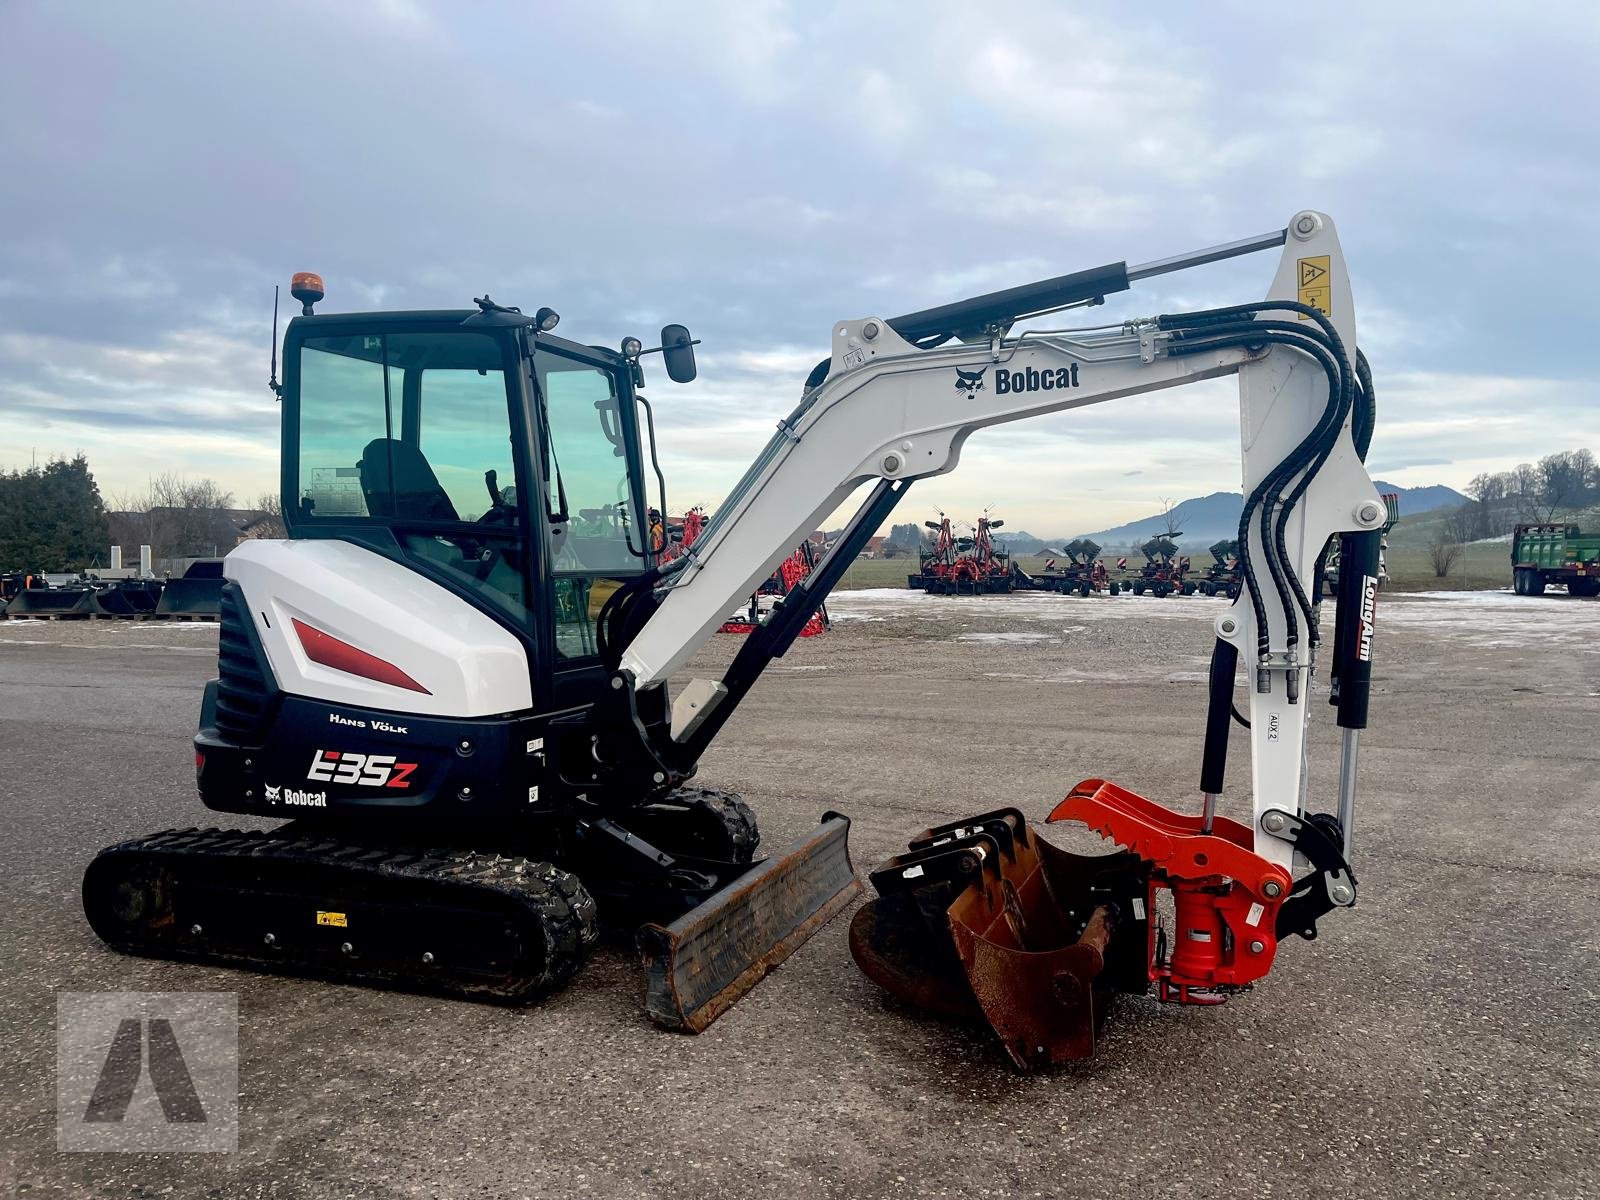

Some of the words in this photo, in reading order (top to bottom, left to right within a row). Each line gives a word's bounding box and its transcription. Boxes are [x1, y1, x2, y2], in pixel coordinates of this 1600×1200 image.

[995, 362, 1080, 395] Bobcat
[1270, 715, 1278, 733] AUX
[284, 788, 327, 808] Bobcat
